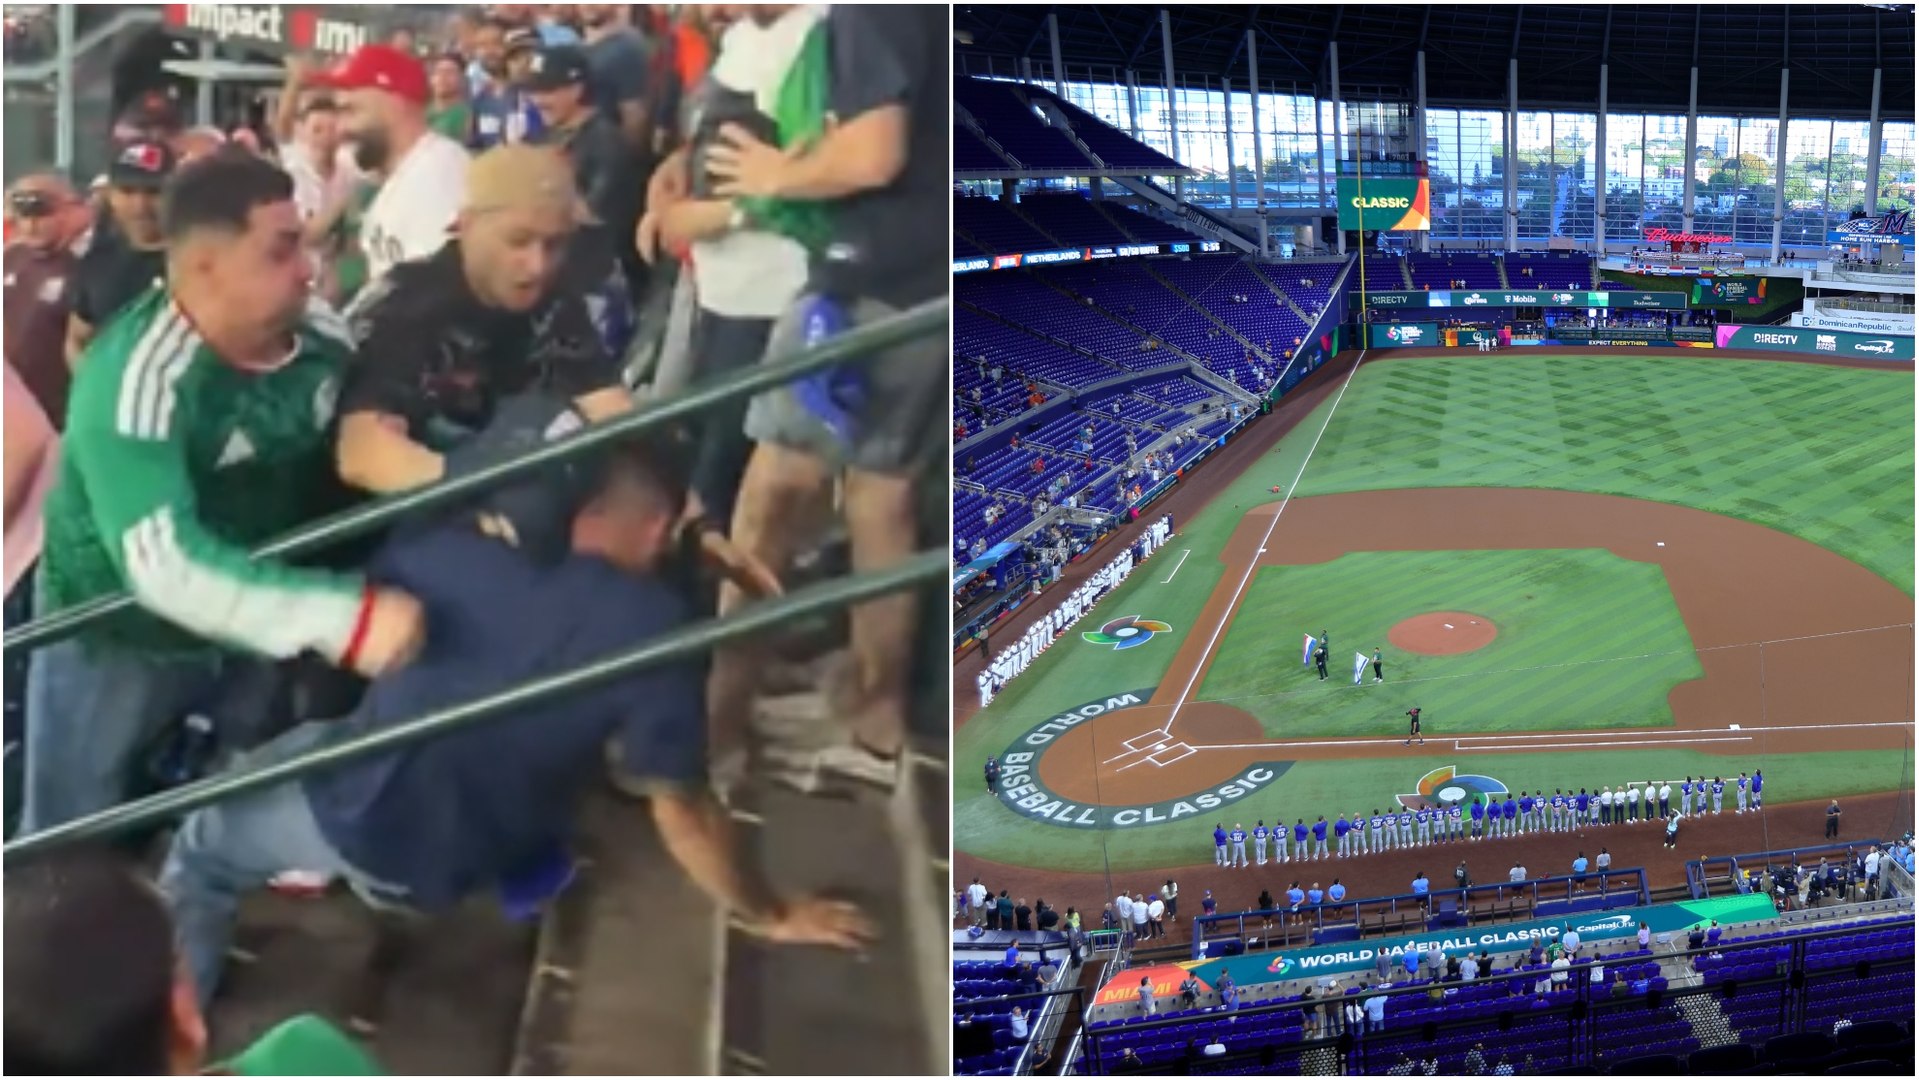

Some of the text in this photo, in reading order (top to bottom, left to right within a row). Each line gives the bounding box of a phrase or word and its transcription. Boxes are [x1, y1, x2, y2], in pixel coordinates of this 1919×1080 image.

[1353, 197, 1409, 208] CLASSIC
[1643, 226, 1733, 243] Budweiser
[1174, 244, 1190, 253] $500
[1027, 252, 1081, 263] NETHERLANDS
[1372, 296, 1408, 304] DIRECTV
[1512, 295, 1537, 303] Mobile
[1753, 333, 1798, 345] DIRECTV
[1002, 693, 1274, 826] WORLD BASEBALL CLASSIC
[1300, 949, 1374, 968] WORLD
[1480, 926, 1560, 945] CLASSIC
